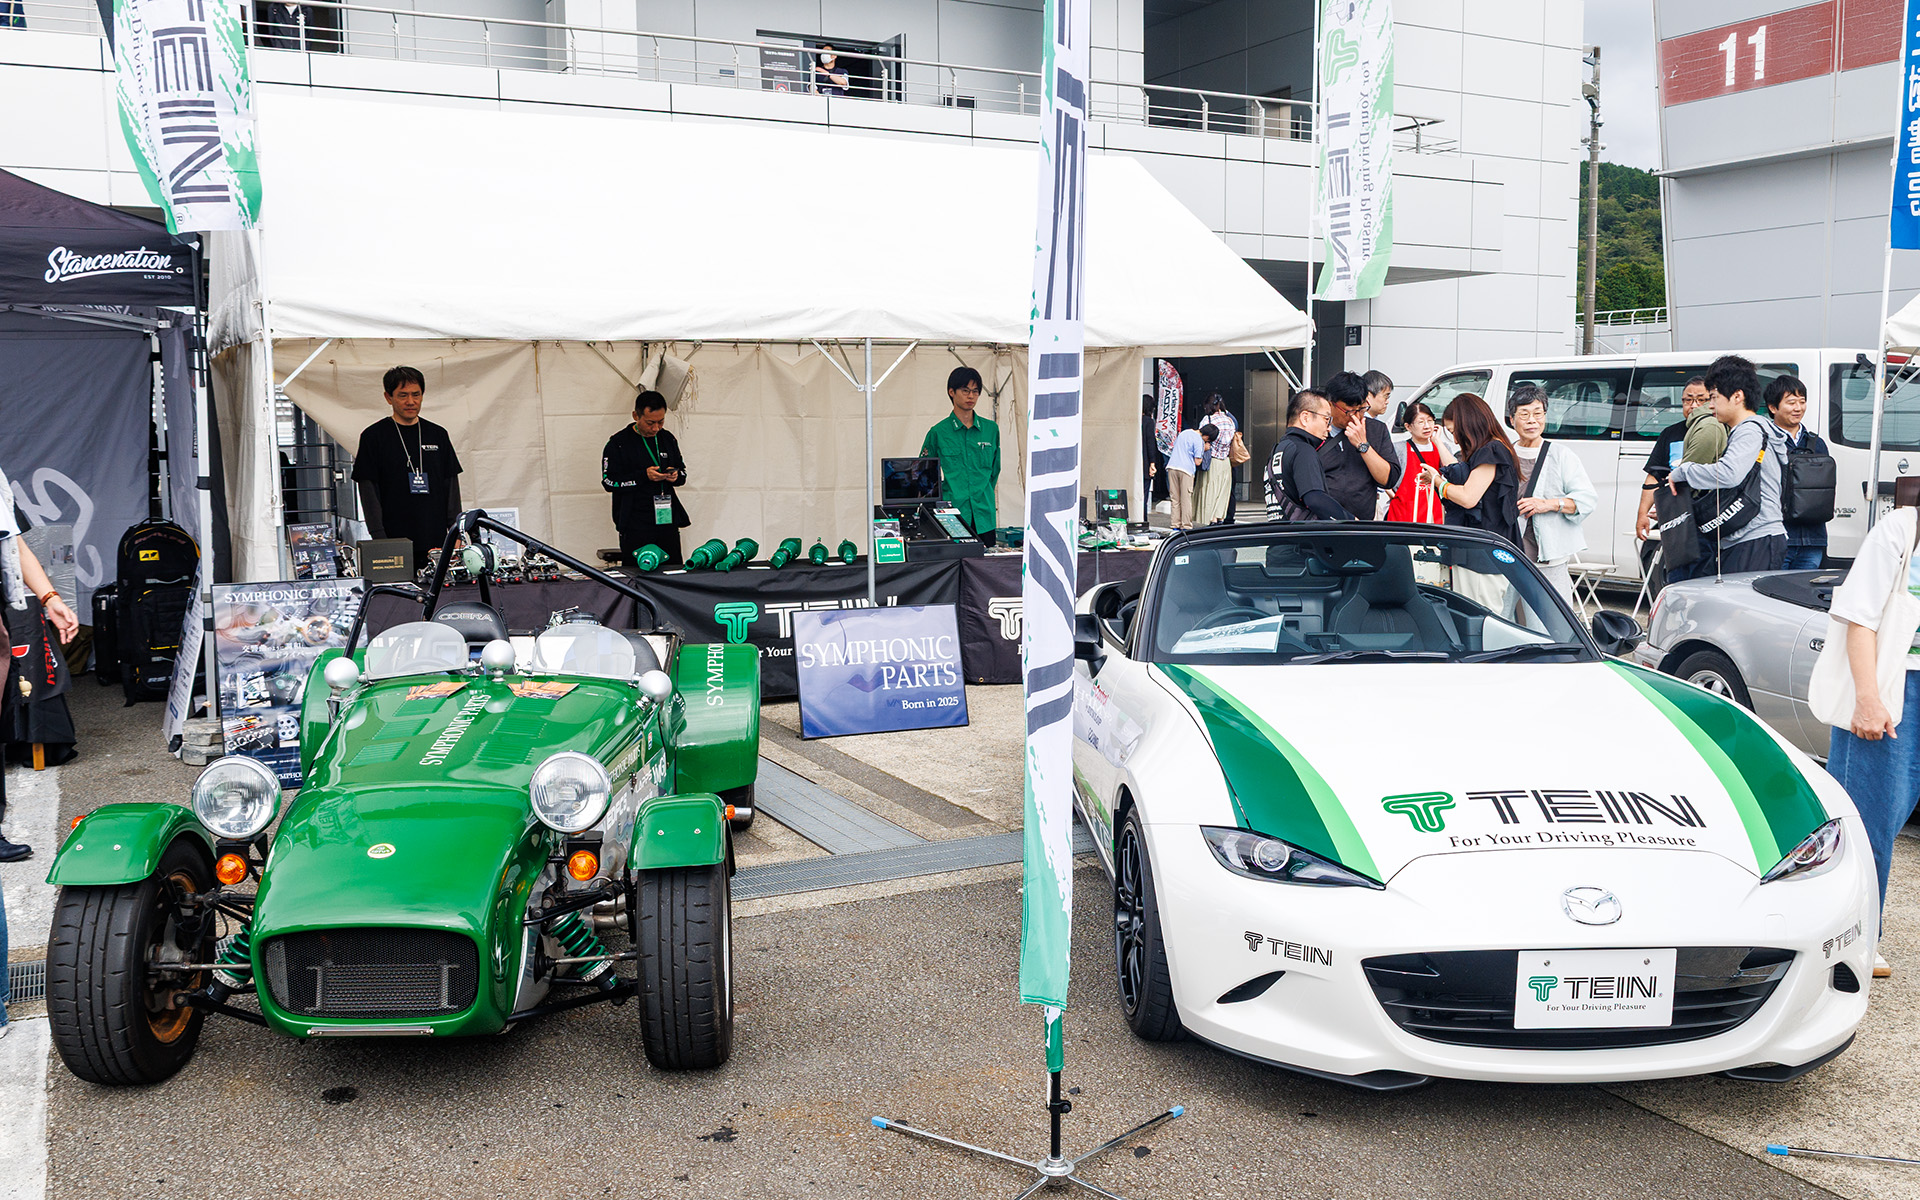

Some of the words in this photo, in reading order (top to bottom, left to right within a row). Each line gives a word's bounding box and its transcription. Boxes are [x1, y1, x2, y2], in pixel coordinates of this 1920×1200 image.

[1718, 25, 1767, 87] 11
[44, 245, 174, 283] Stancenation
[224, 588, 309, 604] SYMPHONIC
[311, 586, 354, 600] PARTS
[438, 612, 493, 622] COBRA
[765, 646, 793, 658] Your
[802, 635, 953, 668] SYMPHONIC
[881, 661, 957, 690] PARTS
[901, 699, 925, 710] Born
[926, 699, 935, 708] in
[937, 697, 959, 708] 2025
[419, 714, 476, 766] SYMPHONIC
[463, 693, 492, 717] PARTS
[1465, 789, 1707, 828] TEIN
[1449, 835, 1481, 848] For
[1486, 833, 1531, 845] Your
[1536, 831, 1615, 847] Driving
[1616, 831, 1697, 848] Pleasure
[1835, 919, 1861, 951] TEIN
[1267, 937, 1332, 966] TEIN
[1563, 976, 1658, 999] TEIN
[1546, 1004, 1560, 1012] For
[1581, 1003, 1612, 1012] Driving
[1613, 1003, 1647, 1011] Pleasure
